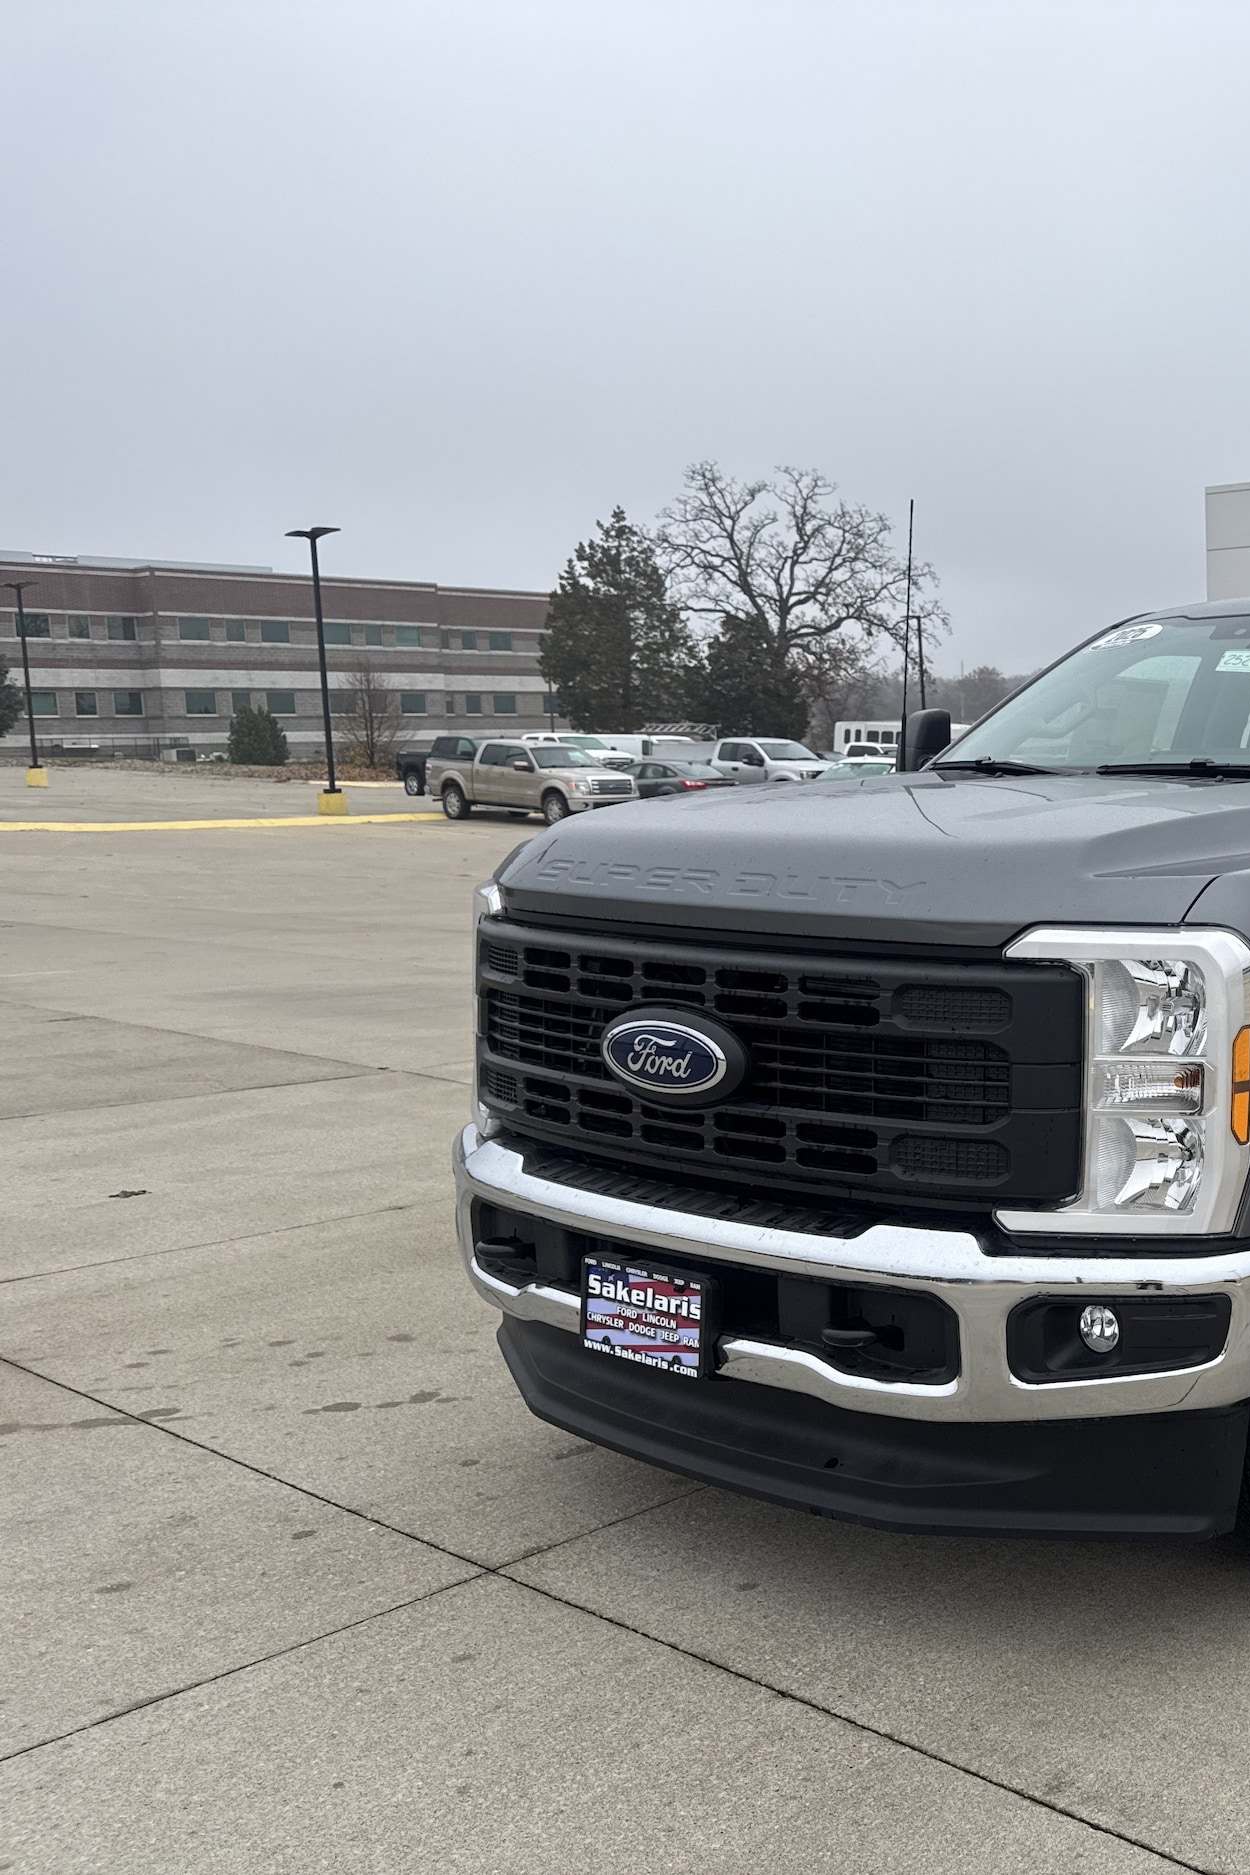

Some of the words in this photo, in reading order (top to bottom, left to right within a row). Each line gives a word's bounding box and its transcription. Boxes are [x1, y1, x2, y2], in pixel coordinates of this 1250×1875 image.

[535, 858, 722, 895] SUPER
[727, 871, 928, 905] DUTY
[626, 1033, 693, 1080] Ford
[585, 1258, 597, 1266] FORD
[602, 1262, 621, 1271] LINCOLN
[626, 1267, 648, 1277] CHRYSLER
[690, 1282, 701, 1290] RAM
[588, 1273, 701, 1320] Sakelaris
[586, 1311, 625, 1329] CHRYSLER
[628, 1322, 656, 1338] DODGE
[660, 1330, 680, 1343] JEEP
[683, 1336, 700, 1349] RAM
[616, 1306, 637, 1319] FORD
[642, 1312, 677, 1330] LINCOLN
